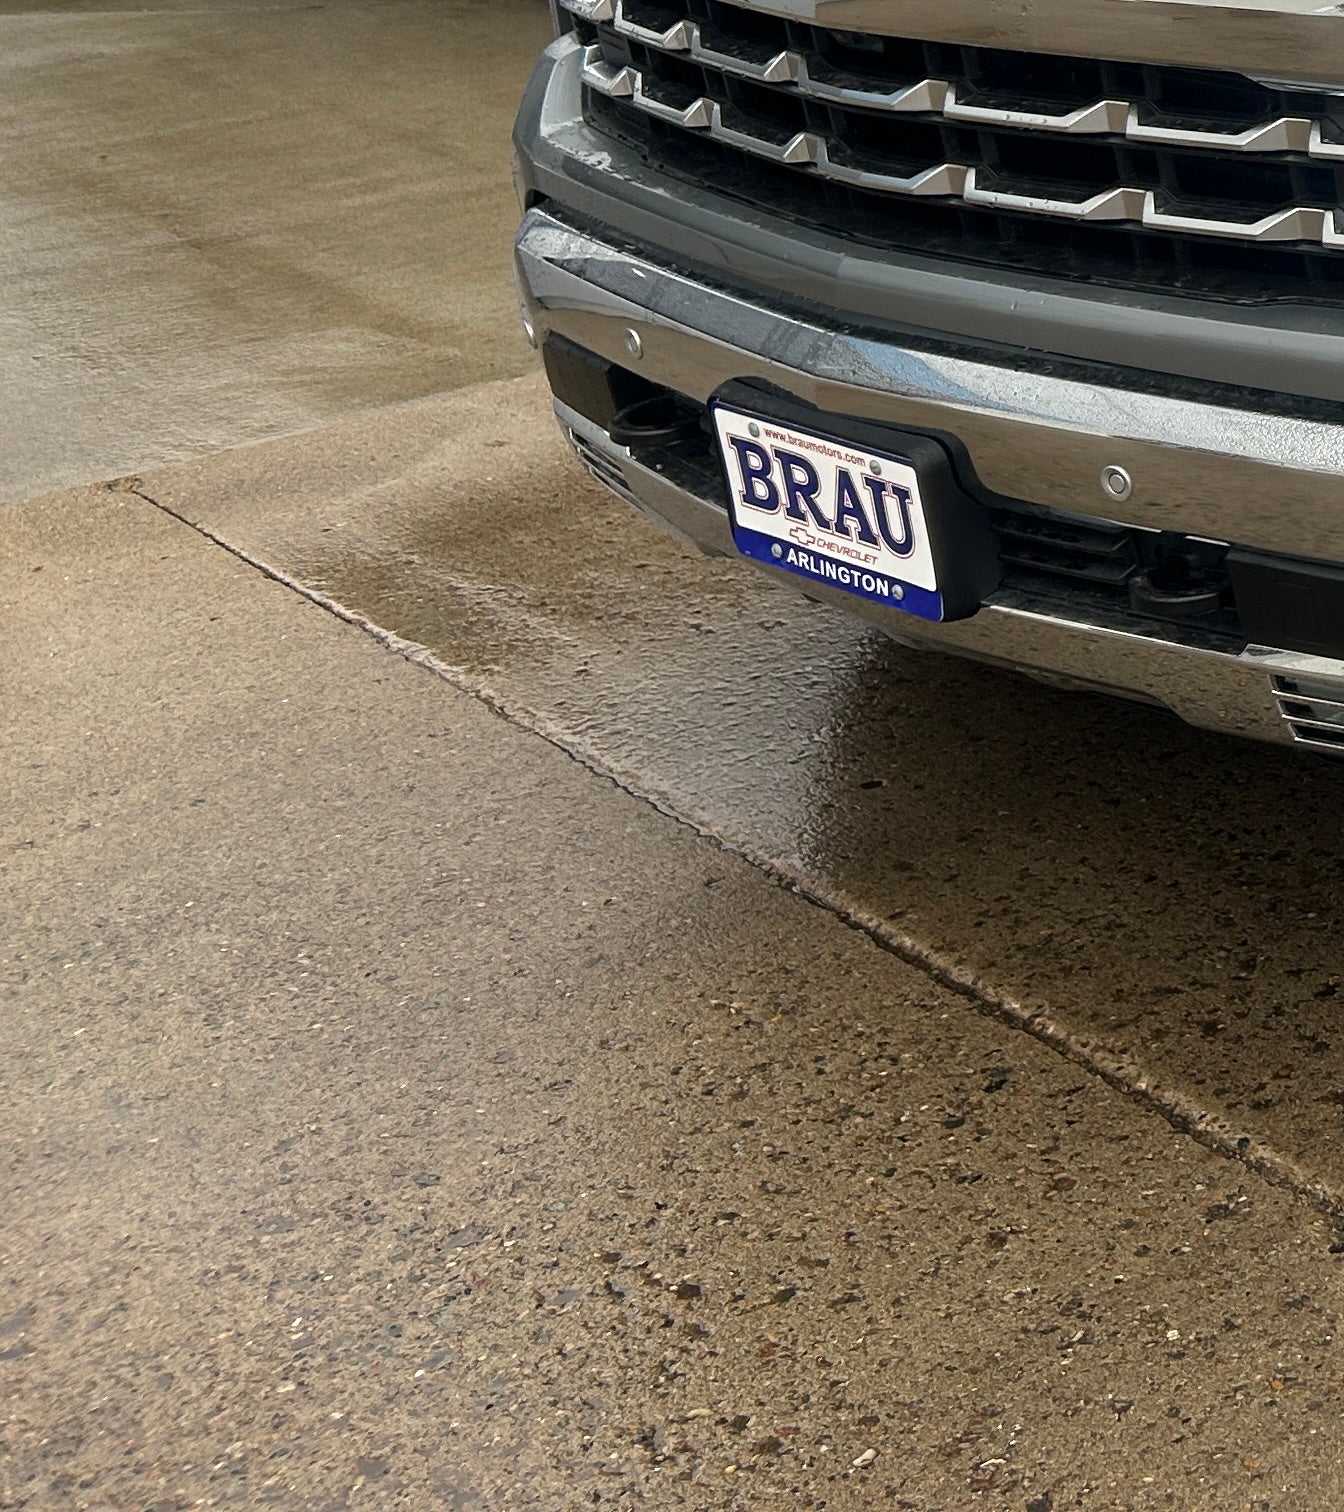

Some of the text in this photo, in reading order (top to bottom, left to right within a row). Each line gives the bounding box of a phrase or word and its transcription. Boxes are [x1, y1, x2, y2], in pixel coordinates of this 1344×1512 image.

[763, 428, 866, 467] www.braumotors.com
[727, 434, 915, 558] BRAU
[786, 547, 889, 597] ARLINGTON
[816, 538, 878, 565] CHEVROLET
